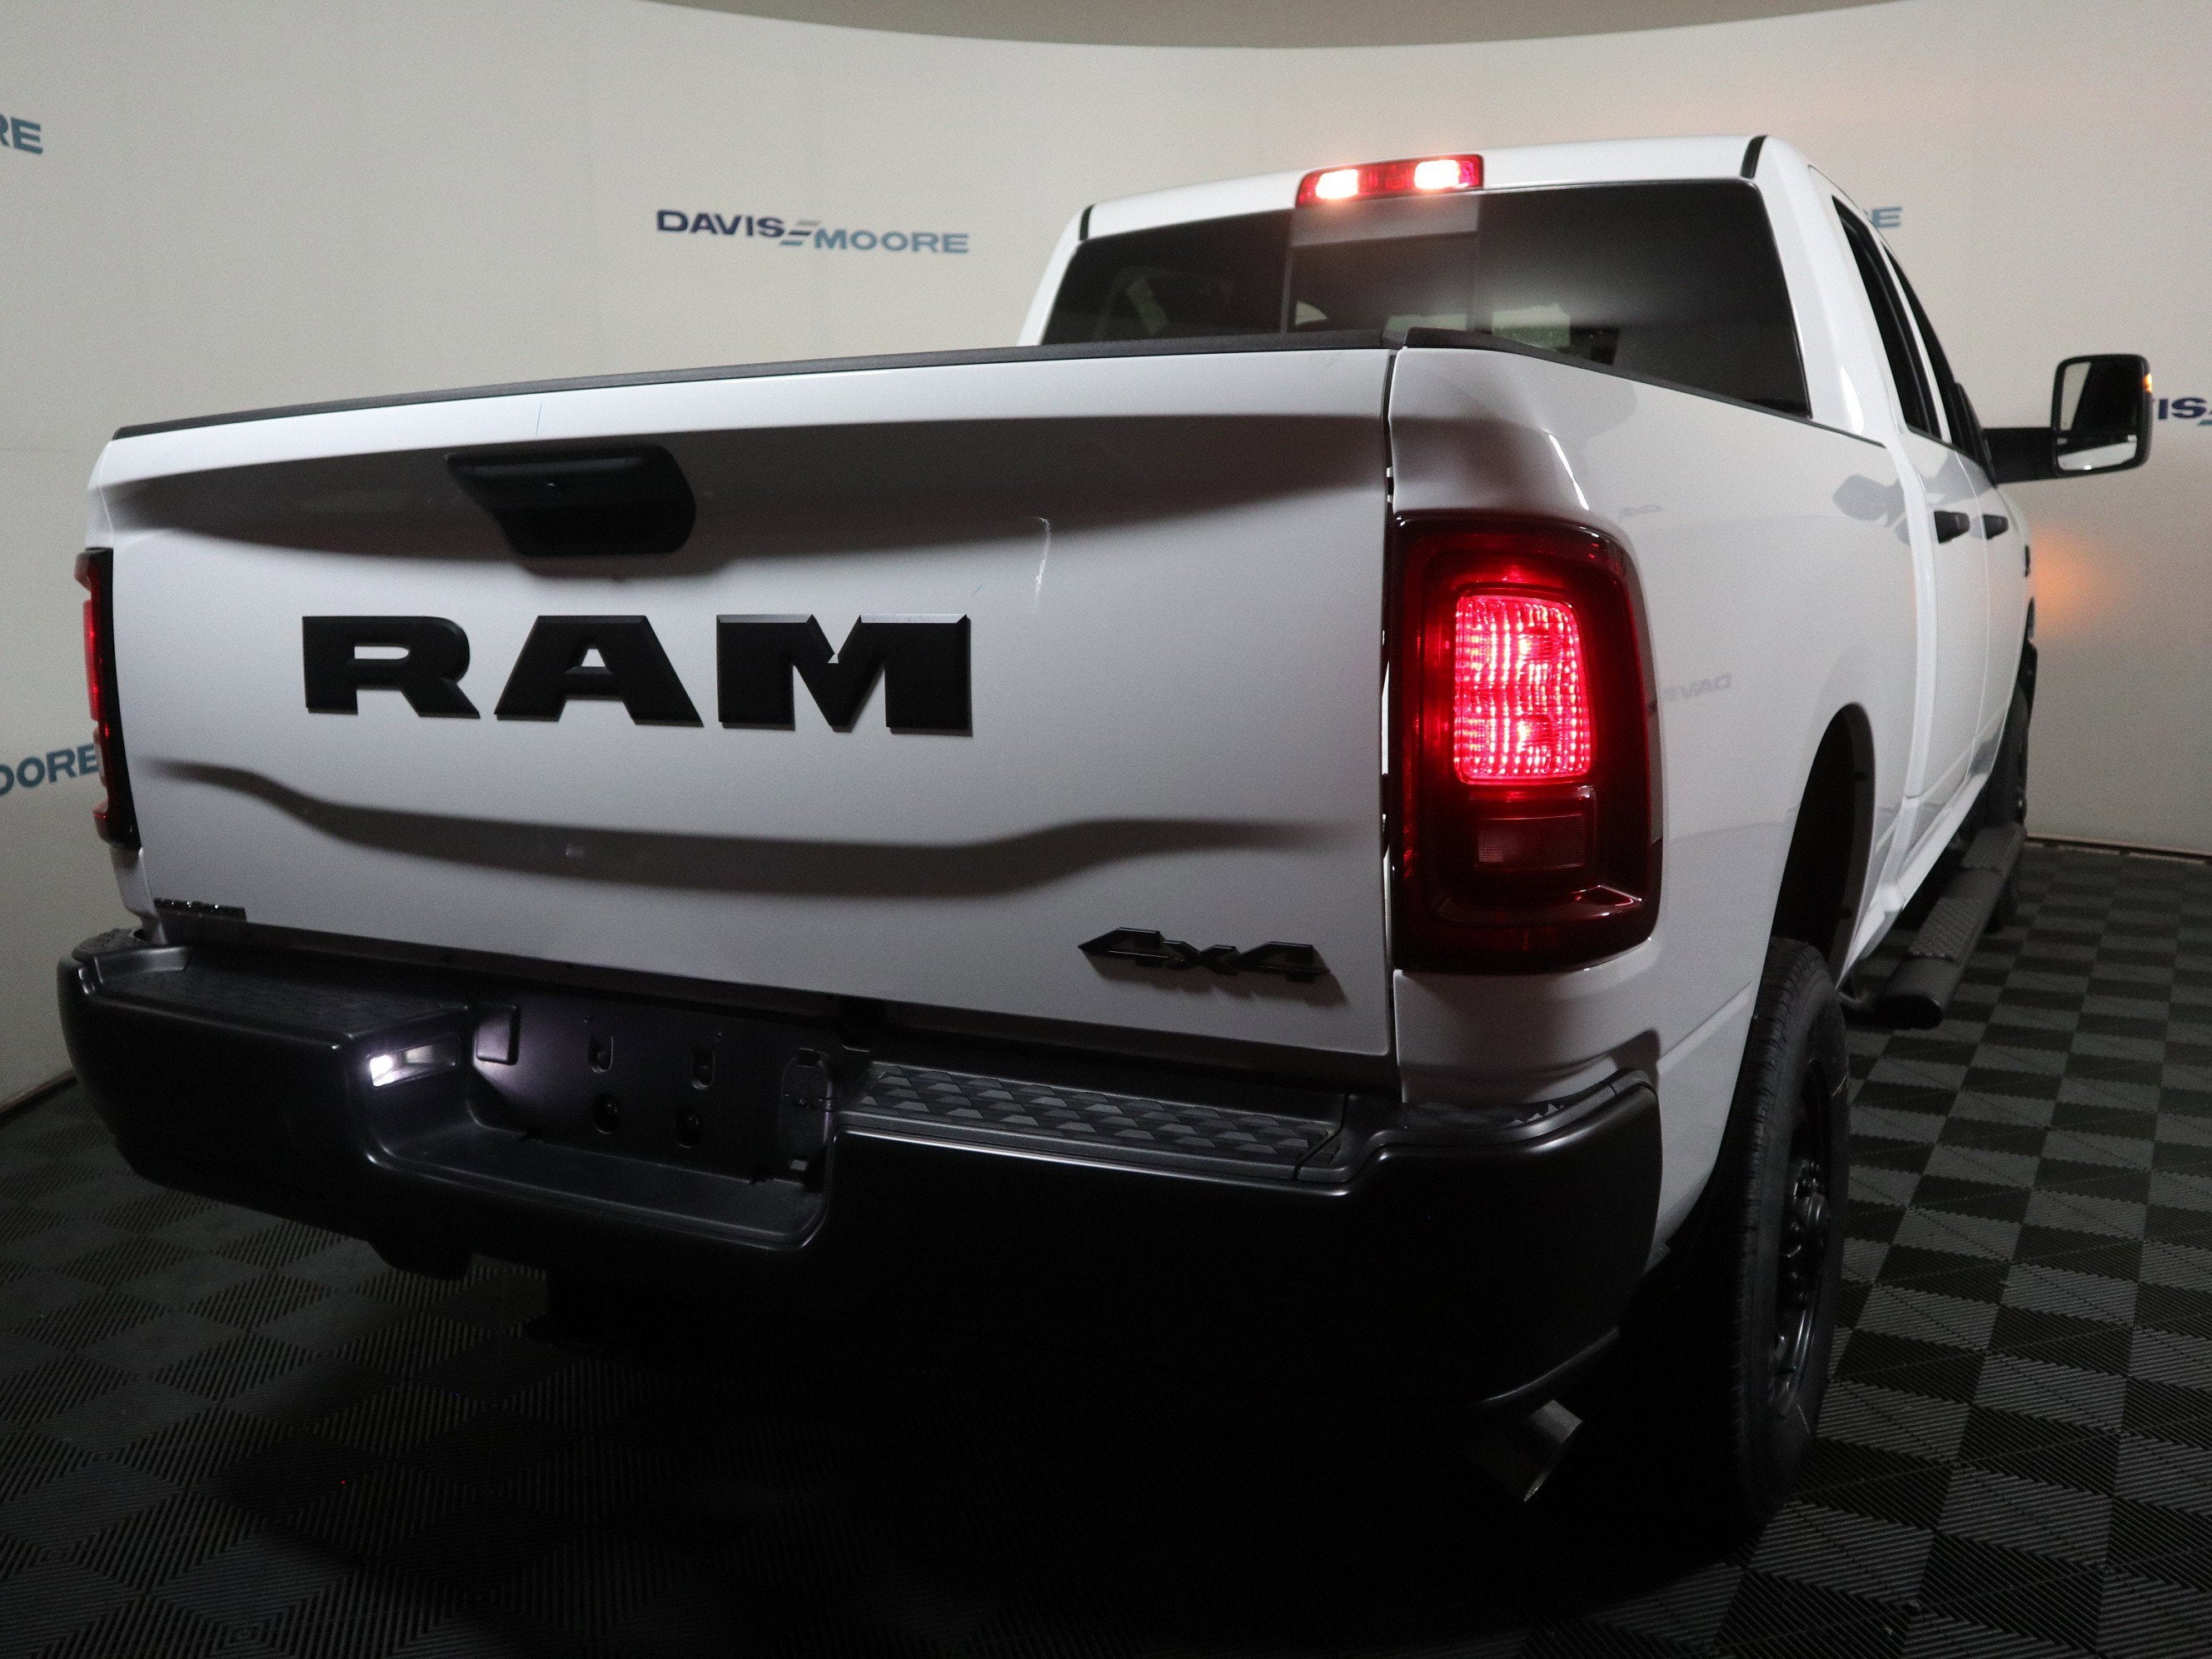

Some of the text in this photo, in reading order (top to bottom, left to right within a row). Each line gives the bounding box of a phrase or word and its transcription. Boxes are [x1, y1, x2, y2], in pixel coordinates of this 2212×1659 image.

[655, 210, 969, 253] DAVIS MOORE
[301, 614, 972, 735] RAM
